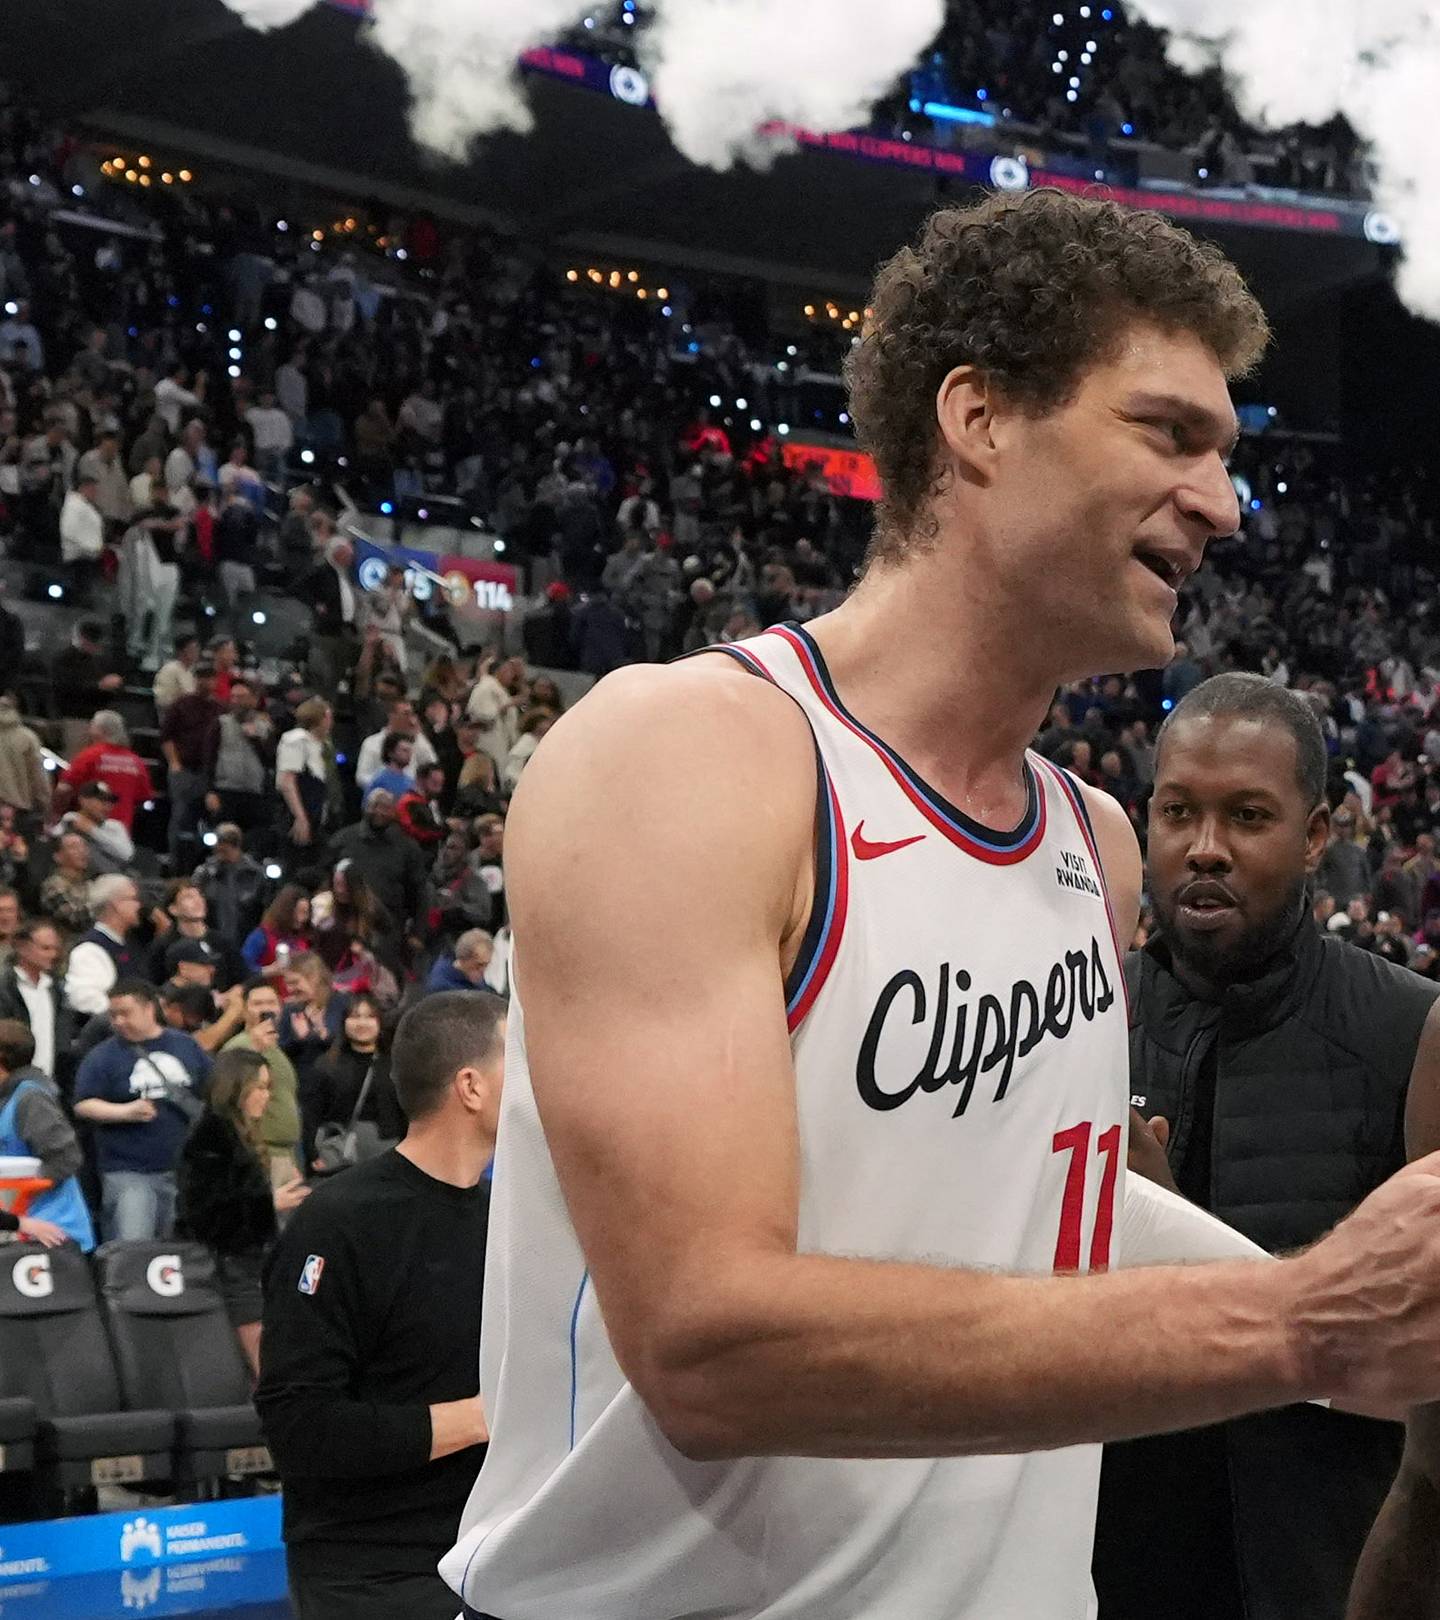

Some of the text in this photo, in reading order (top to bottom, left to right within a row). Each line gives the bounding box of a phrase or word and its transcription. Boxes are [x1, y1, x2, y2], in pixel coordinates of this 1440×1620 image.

[1056, 867, 1101, 898] RWANDA
[1060, 850, 1088, 874] VISIT
[856, 935, 1114, 1119] Clippers
[1053, 1121, 1122, 1275] 11
[12, 1253, 54, 1298] G
[147, 1254, 184, 1297] G
